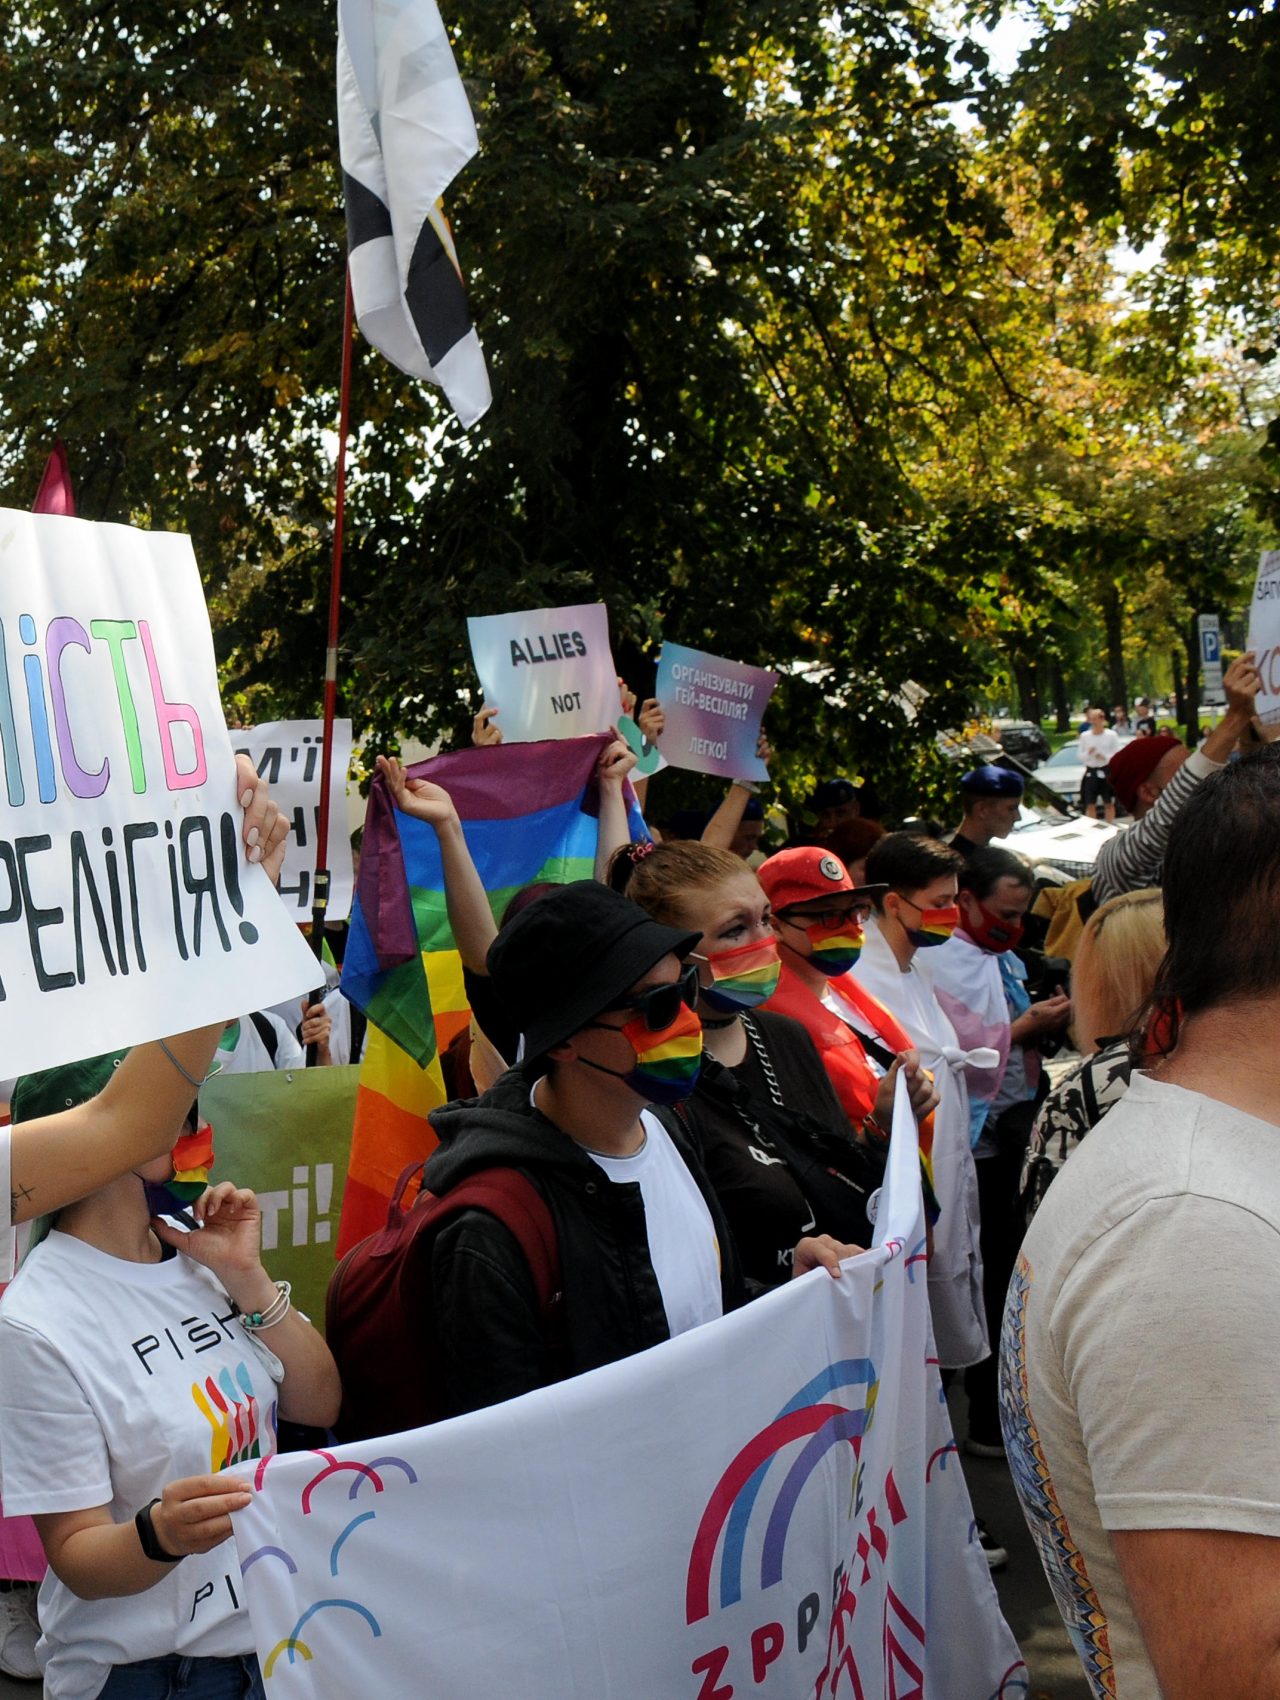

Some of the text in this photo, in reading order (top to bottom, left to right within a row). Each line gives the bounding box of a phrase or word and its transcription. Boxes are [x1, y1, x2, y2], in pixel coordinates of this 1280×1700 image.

[510, 631, 587, 667] ALLIES
[671, 664, 755, 700] ОРГАНІЗУВАТИ
[551, 692, 581, 714] NOT
[675, 686, 748, 720] ГЕЙ-ВЕСІЛЛЯ?
[688, 737, 728, 760] ЛЕГКО!
